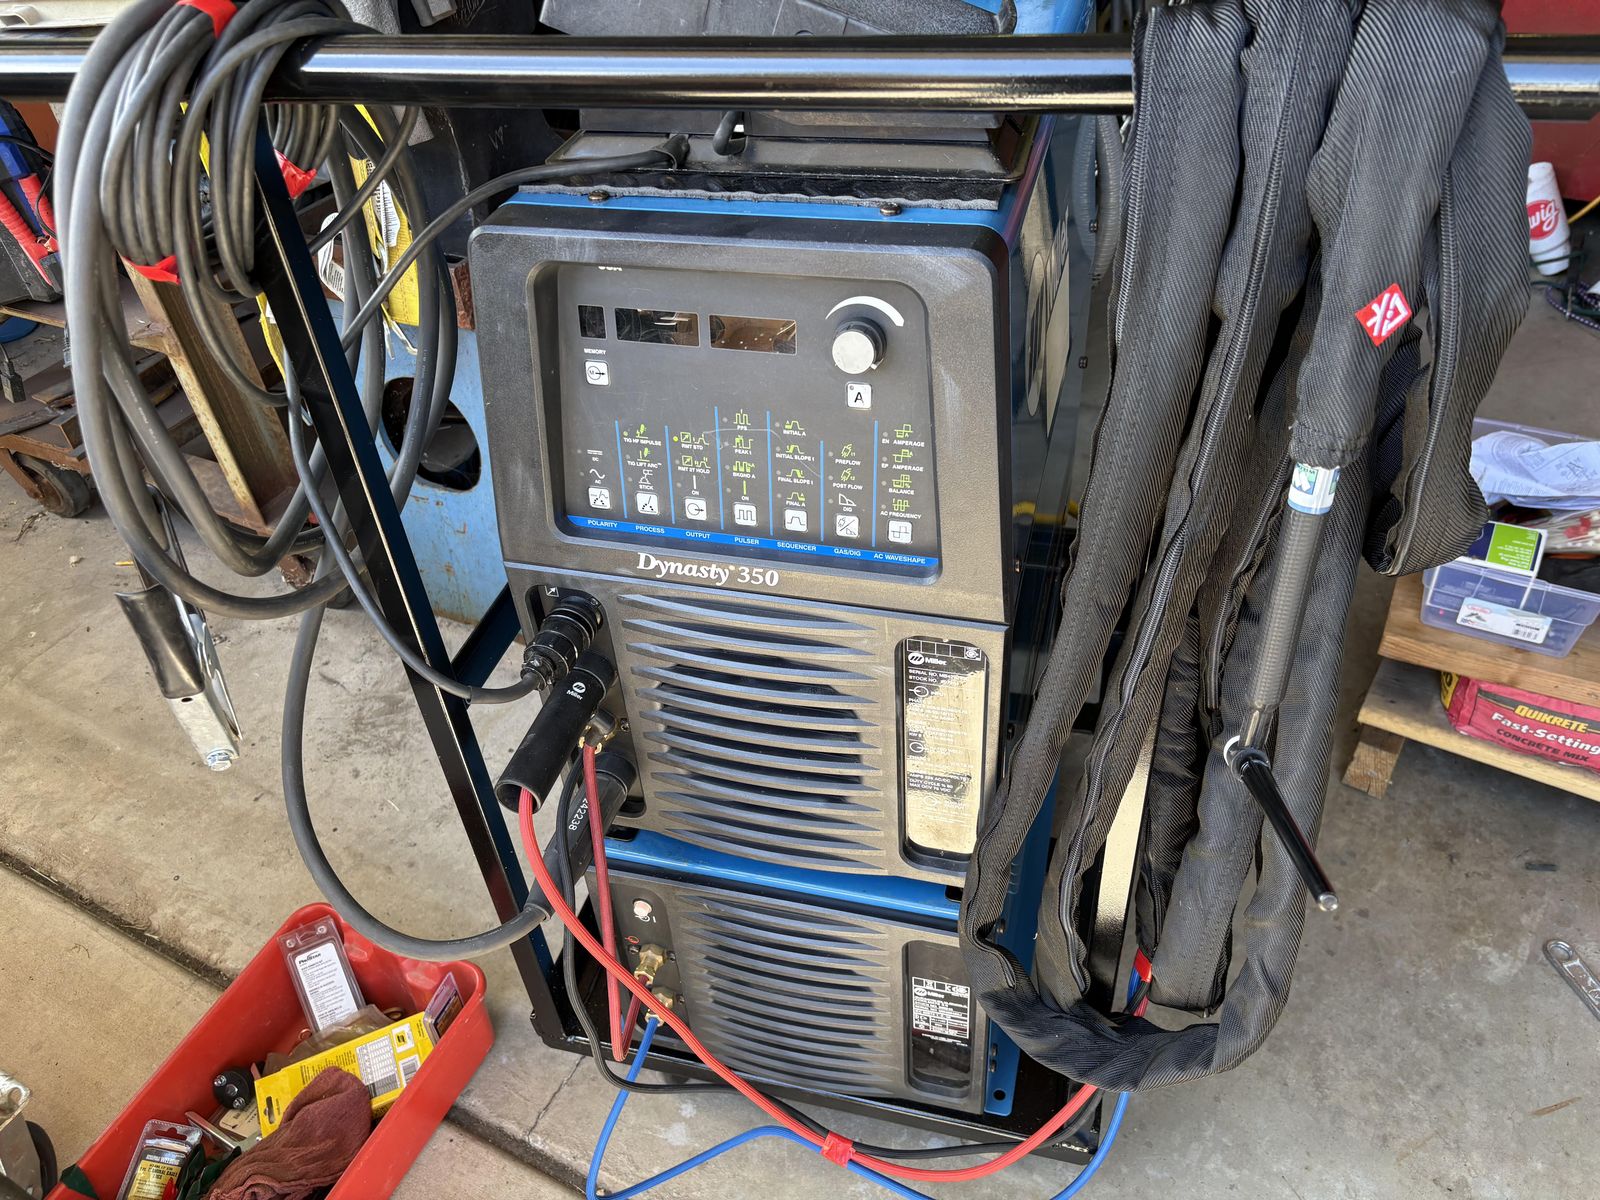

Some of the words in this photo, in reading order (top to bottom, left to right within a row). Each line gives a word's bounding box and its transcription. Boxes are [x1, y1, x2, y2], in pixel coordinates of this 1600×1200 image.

[1529, 202, 1557, 231] wig
[854, 392, 864, 404] A
[889, 511, 922, 519] FREQUENCY
[587, 519, 618, 528] POLARITY
[635, 525, 665, 534] PROCESS
[777, 541, 817, 551] SEQUENCER
[834, 548, 861, 556] GAS/DIG
[885, 554, 926, 564] WAVESHAPE
[737, 566, 779, 587] 350
[566, 689, 582, 700] Miller
[1514, 704, 1589, 733] QUIKRETE
[1492, 712, 1600, 754] Fast-Setting
[1497, 729, 1560, 754] CONCRETE
[1563, 751, 1589, 762] MIX
